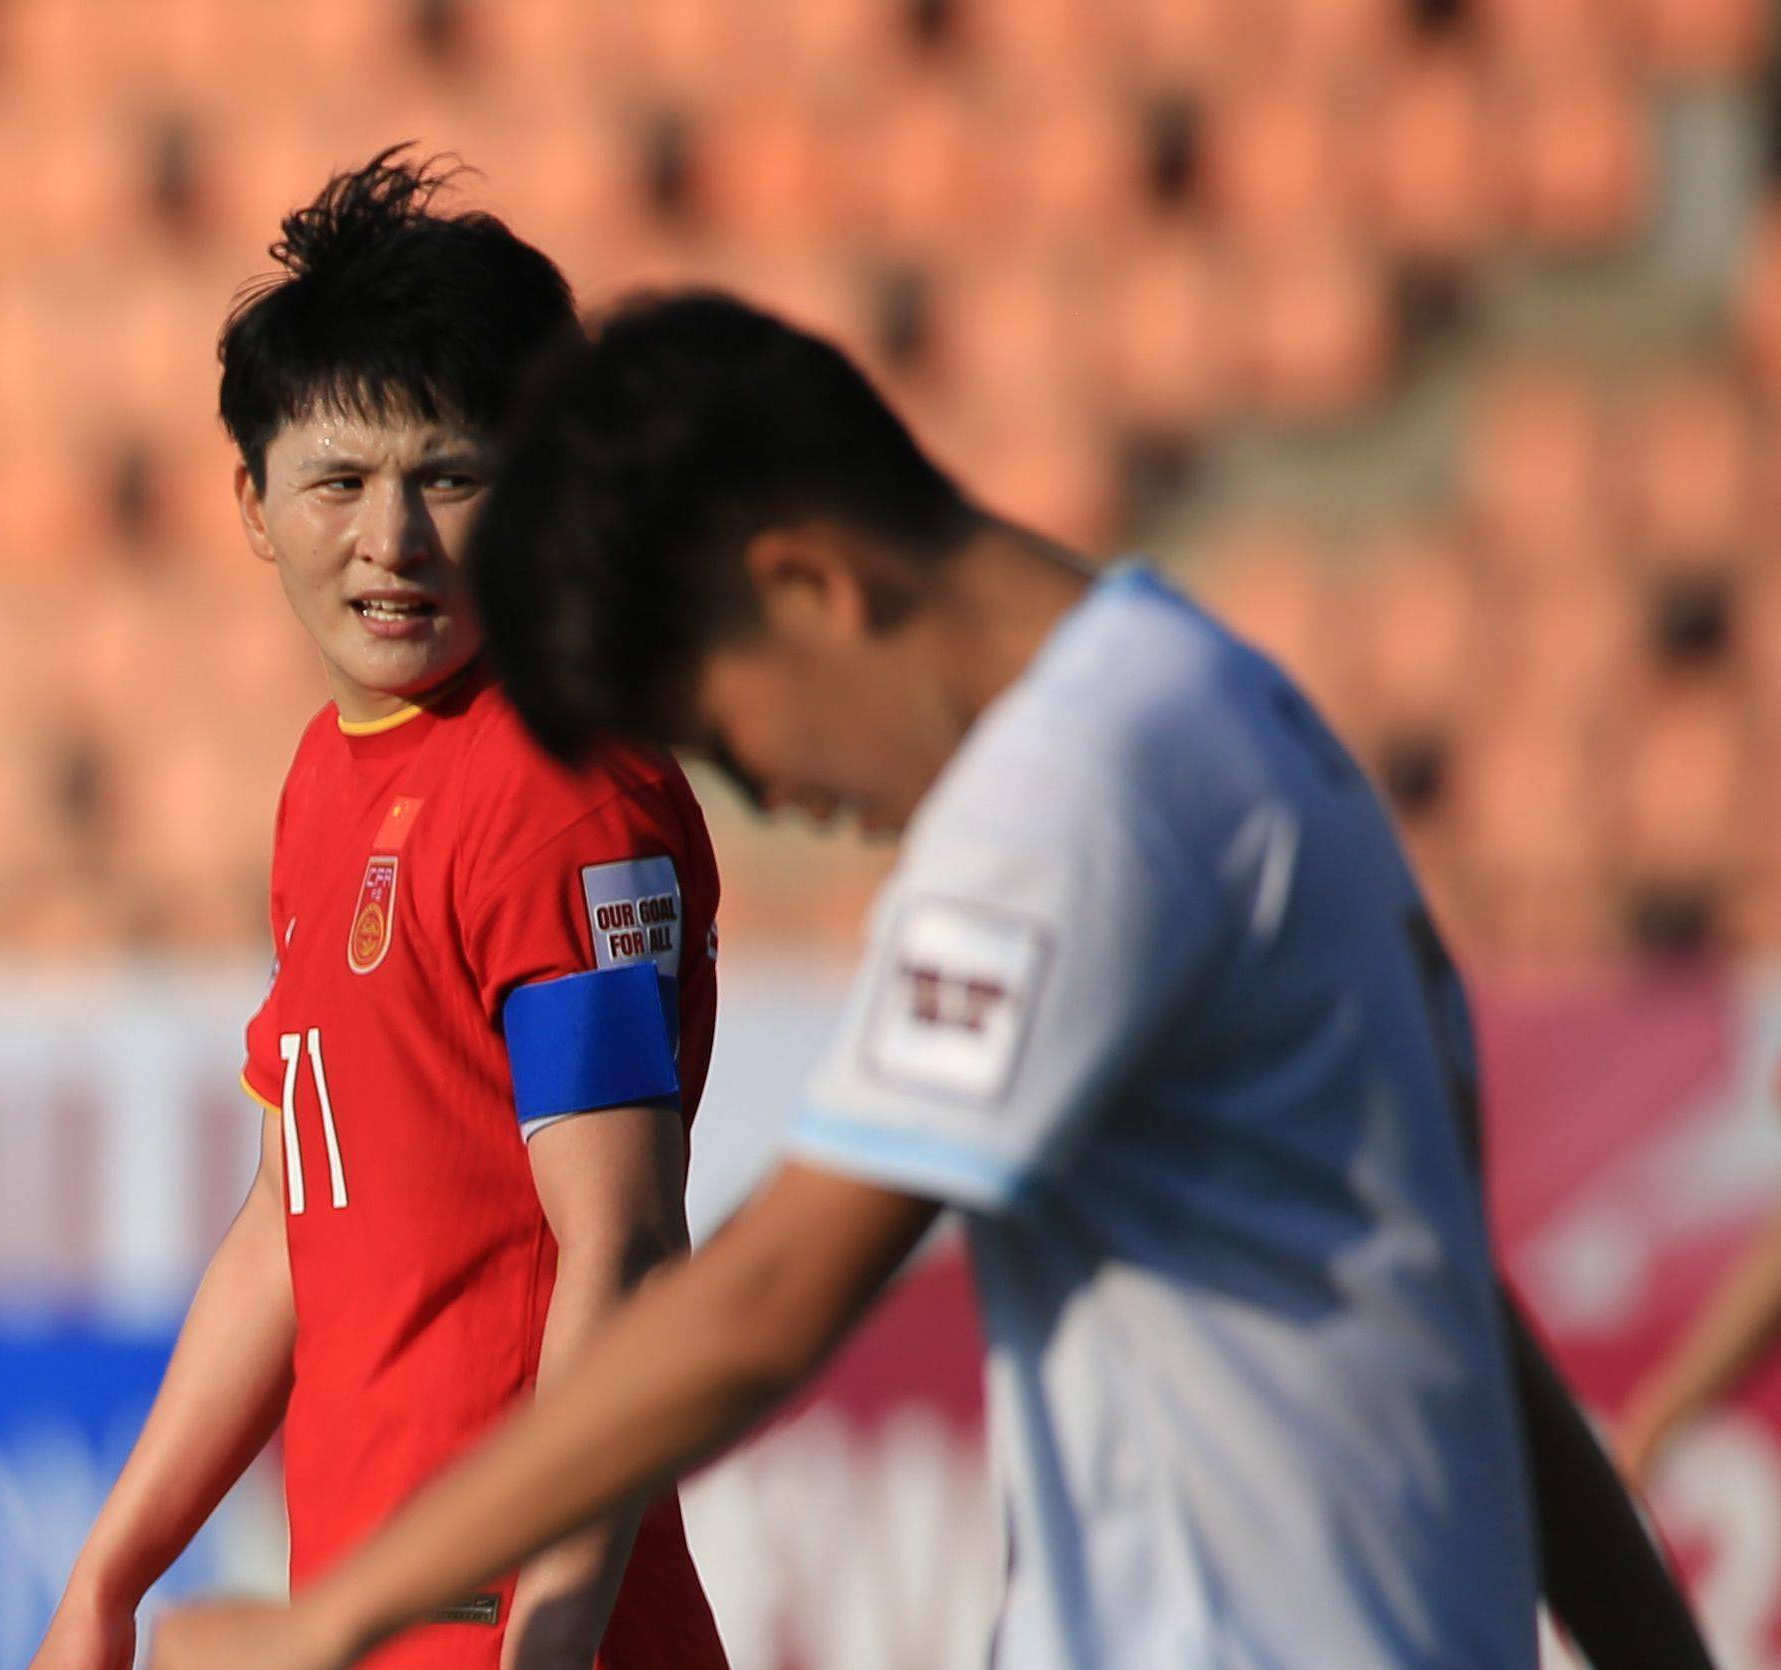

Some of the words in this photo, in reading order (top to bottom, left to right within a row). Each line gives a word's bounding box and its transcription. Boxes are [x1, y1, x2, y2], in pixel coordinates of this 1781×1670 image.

[596, 902, 636, 930] OUR
[638, 895, 678, 924] GOAL
[609, 931, 645, 958] FOR
[648, 926, 673, 954] ALL
[279, 1027, 349, 1216] 11
